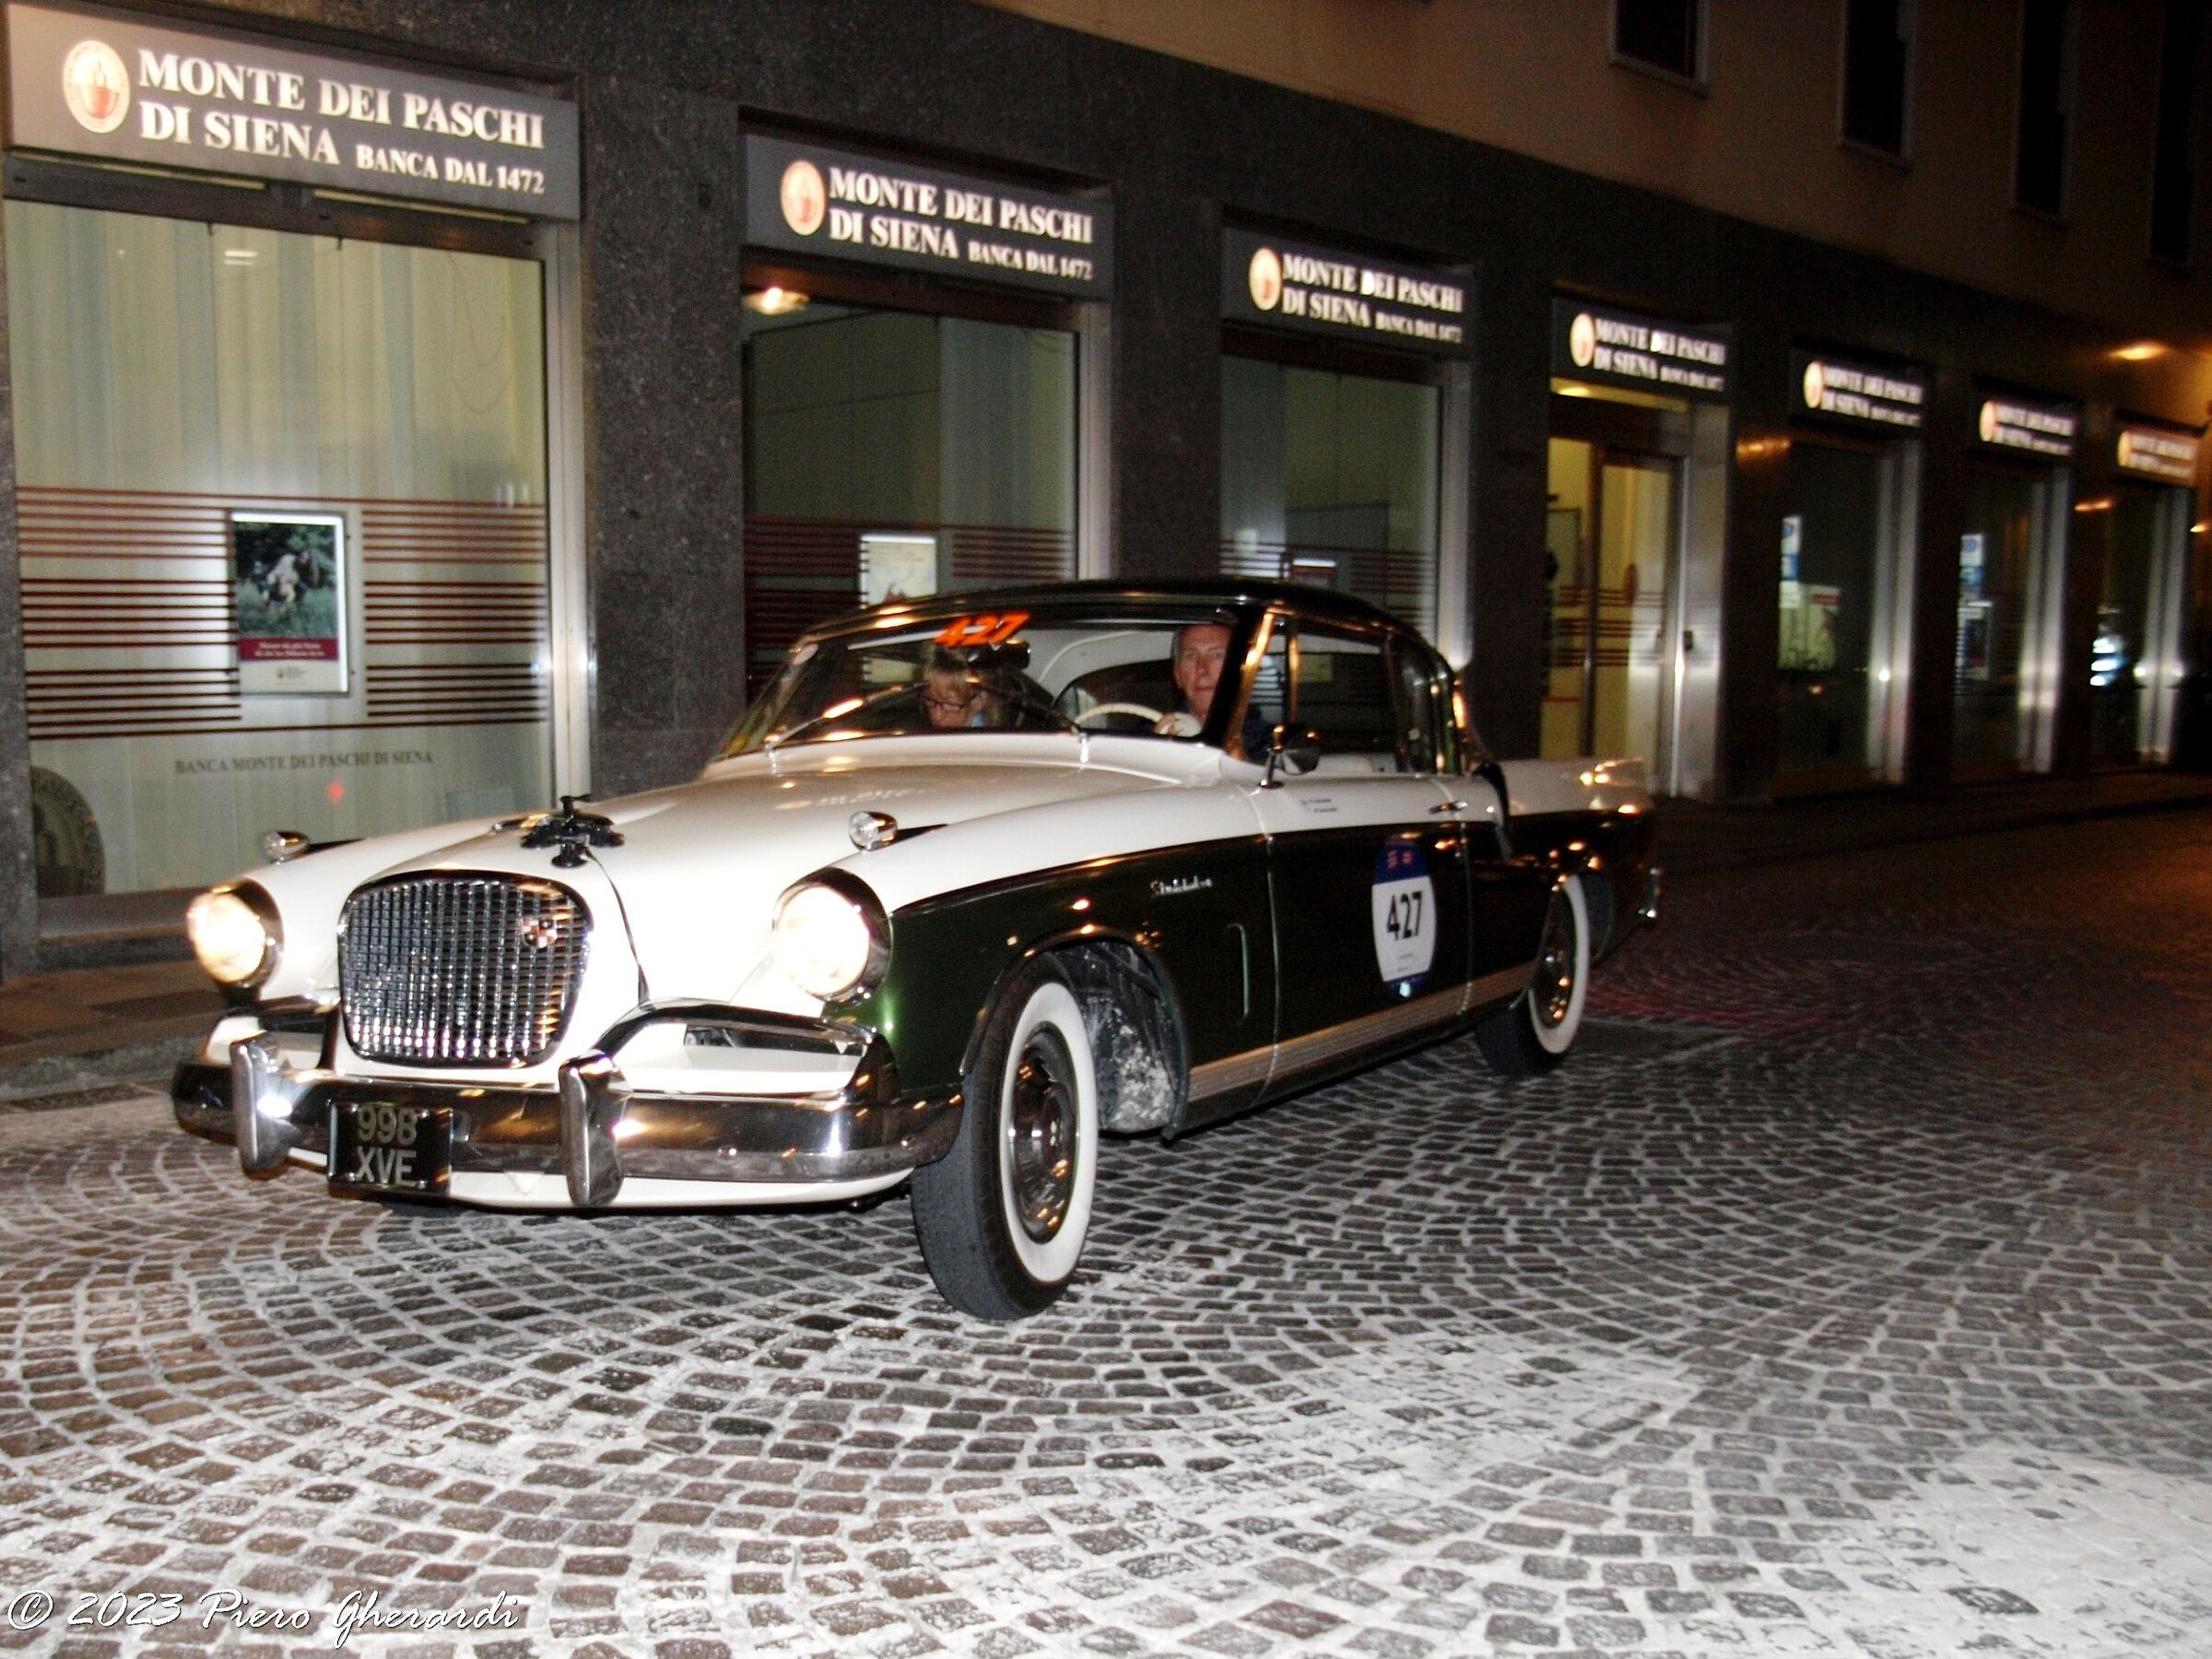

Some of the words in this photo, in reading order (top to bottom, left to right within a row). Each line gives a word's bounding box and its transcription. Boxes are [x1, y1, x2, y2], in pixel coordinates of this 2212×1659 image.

[138, 49, 305, 111] MONTE
[318, 78, 391, 125] DEI
[403, 93, 544, 148] PASCHI
[139, 101, 191, 145] DI
[205, 112, 340, 165] SIENA
[356, 145, 438, 180] BANCA
[445, 157, 493, 187] DAL
[497, 167, 545, 194] 1472
[829, 167, 937, 216] MONTE
[945, 189, 993, 226] DEI
[999, 199, 1092, 244] PASCHI
[829, 208, 863, 244] DI
[870, 215, 959, 259] SIENA
[968, 241, 1023, 270] BANCA
[1025, 253, 1058, 275] DAL
[1282, 287, 1306, 316] DI
[1310, 292, 1371, 328] SIENA
[1283, 253, 1357, 292] MONTE
[1359, 268, 1394, 300] DEI
[1397, 277, 1463, 312] PASCHI
[935, 613, 1030, 648] 427
[175, 759, 228, 774] BANCA
[232, 756, 286, 771] MONTE
[290, 755, 314, 769] DEI
[320, 752, 370, 768] PASCHI
[374, 751, 388, 765] DI
[392, 750, 432, 764] SIENA
[1387, 890, 1422, 941] 427
[357, 1106, 418, 1146] 998
[357, 1146, 418, 1185] XVE
